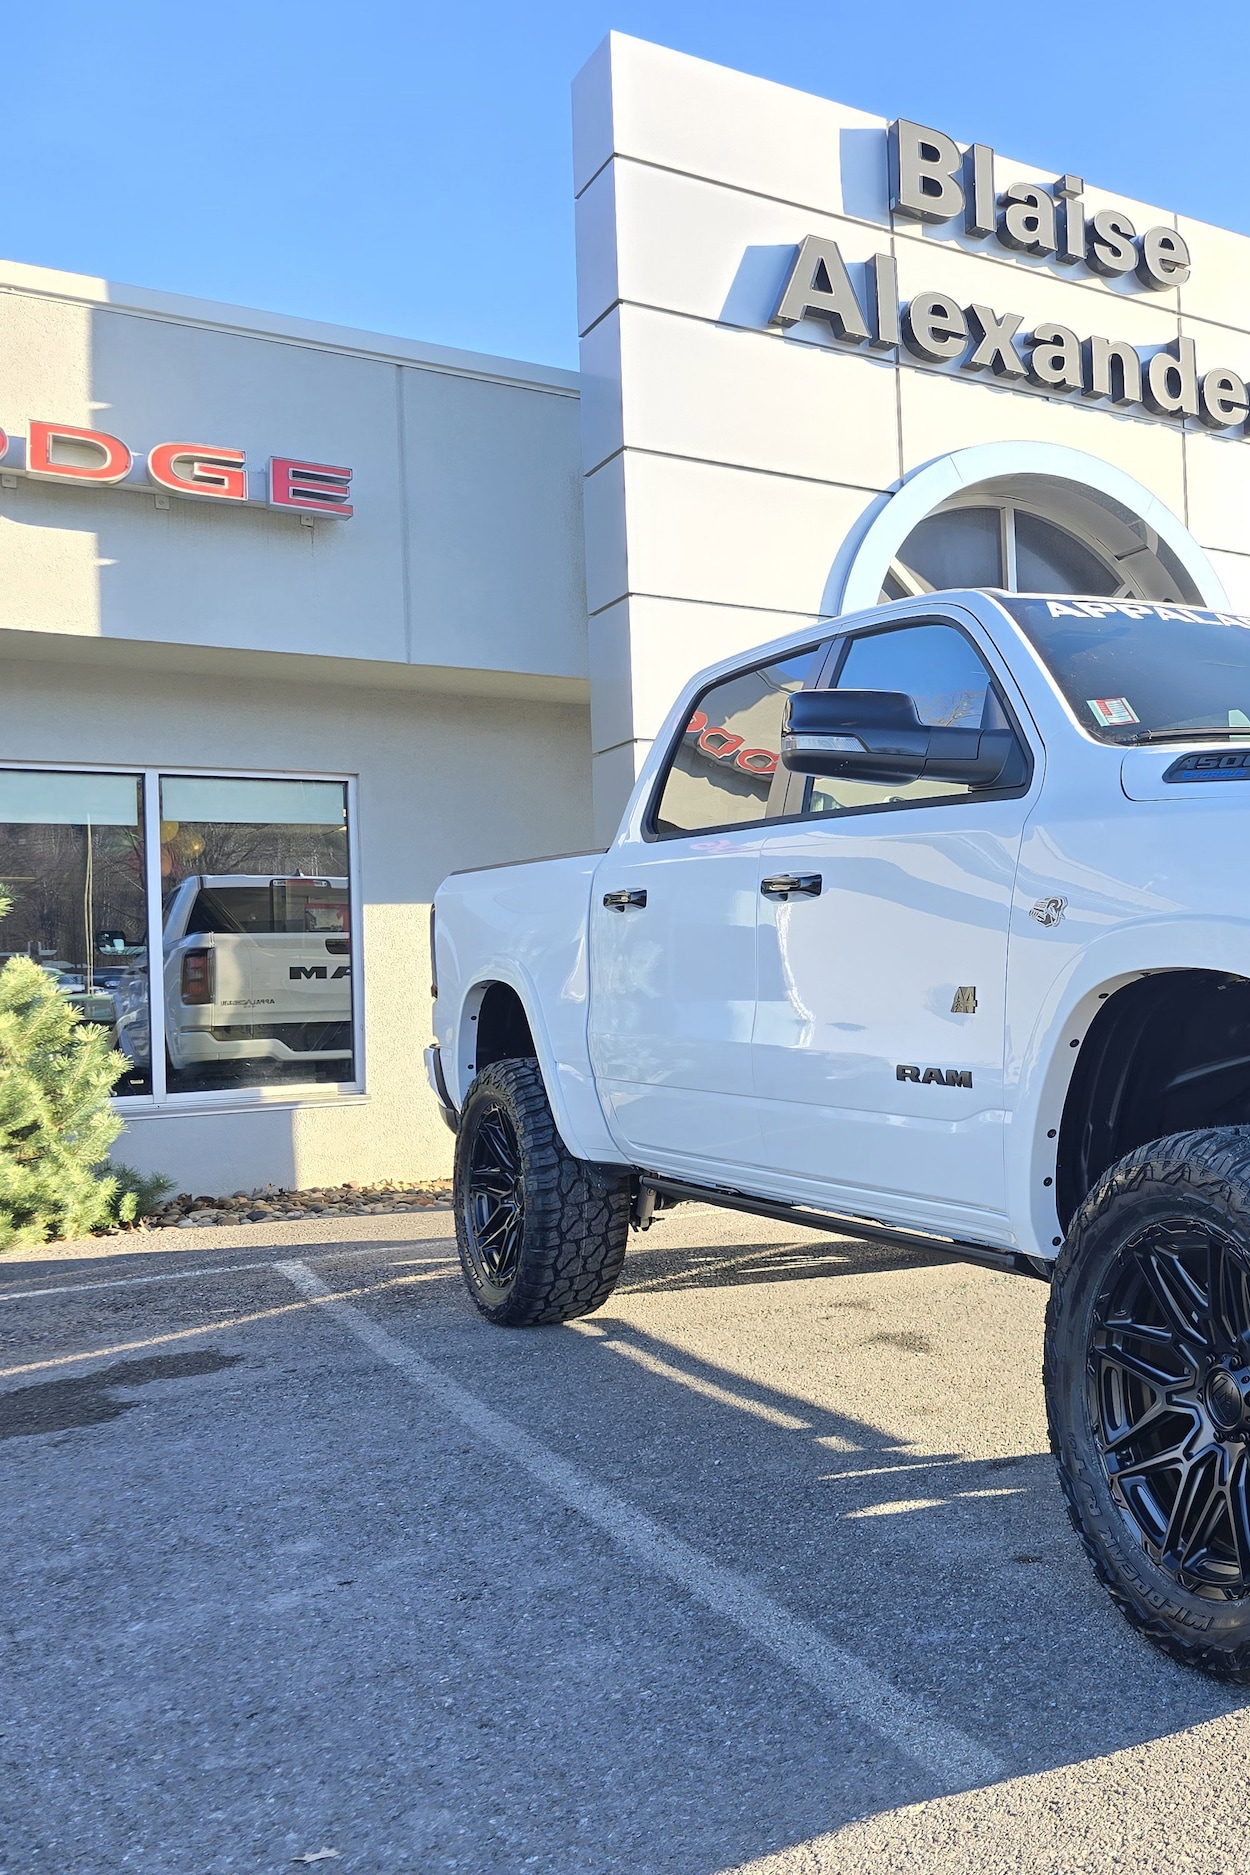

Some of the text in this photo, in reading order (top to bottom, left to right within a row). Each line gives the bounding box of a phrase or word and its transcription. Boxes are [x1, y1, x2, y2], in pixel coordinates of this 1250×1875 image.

[889, 118, 1191, 291] Blaise
[0, 418, 354, 522] DGE
[895, 1064, 974, 1089] RAM
[1098, 1526, 1214, 1632] WILDPEAK
